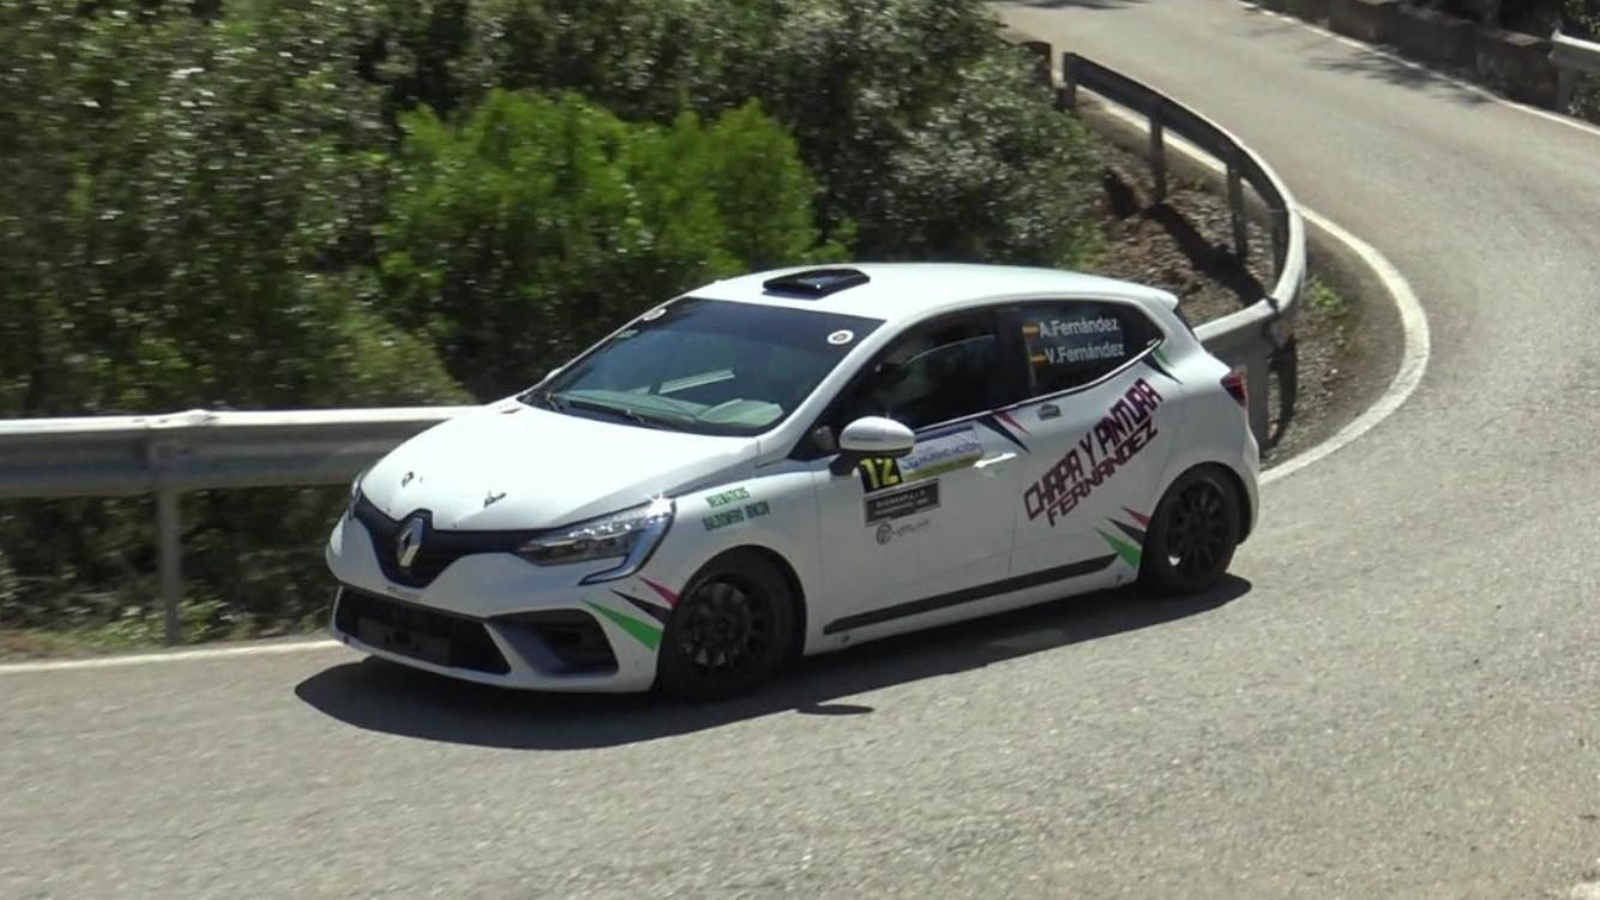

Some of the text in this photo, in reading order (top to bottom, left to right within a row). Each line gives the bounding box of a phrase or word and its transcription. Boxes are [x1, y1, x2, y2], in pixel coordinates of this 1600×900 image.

[1038, 317, 1120, 338] A.Fernández
[1045, 341, 1125, 364] V.Fernández
[1023, 378, 1163, 520] CHAPA Y PINTURA
[860, 457, 900, 488] 12
[1046, 417, 1158, 527] FERNANDEZ
